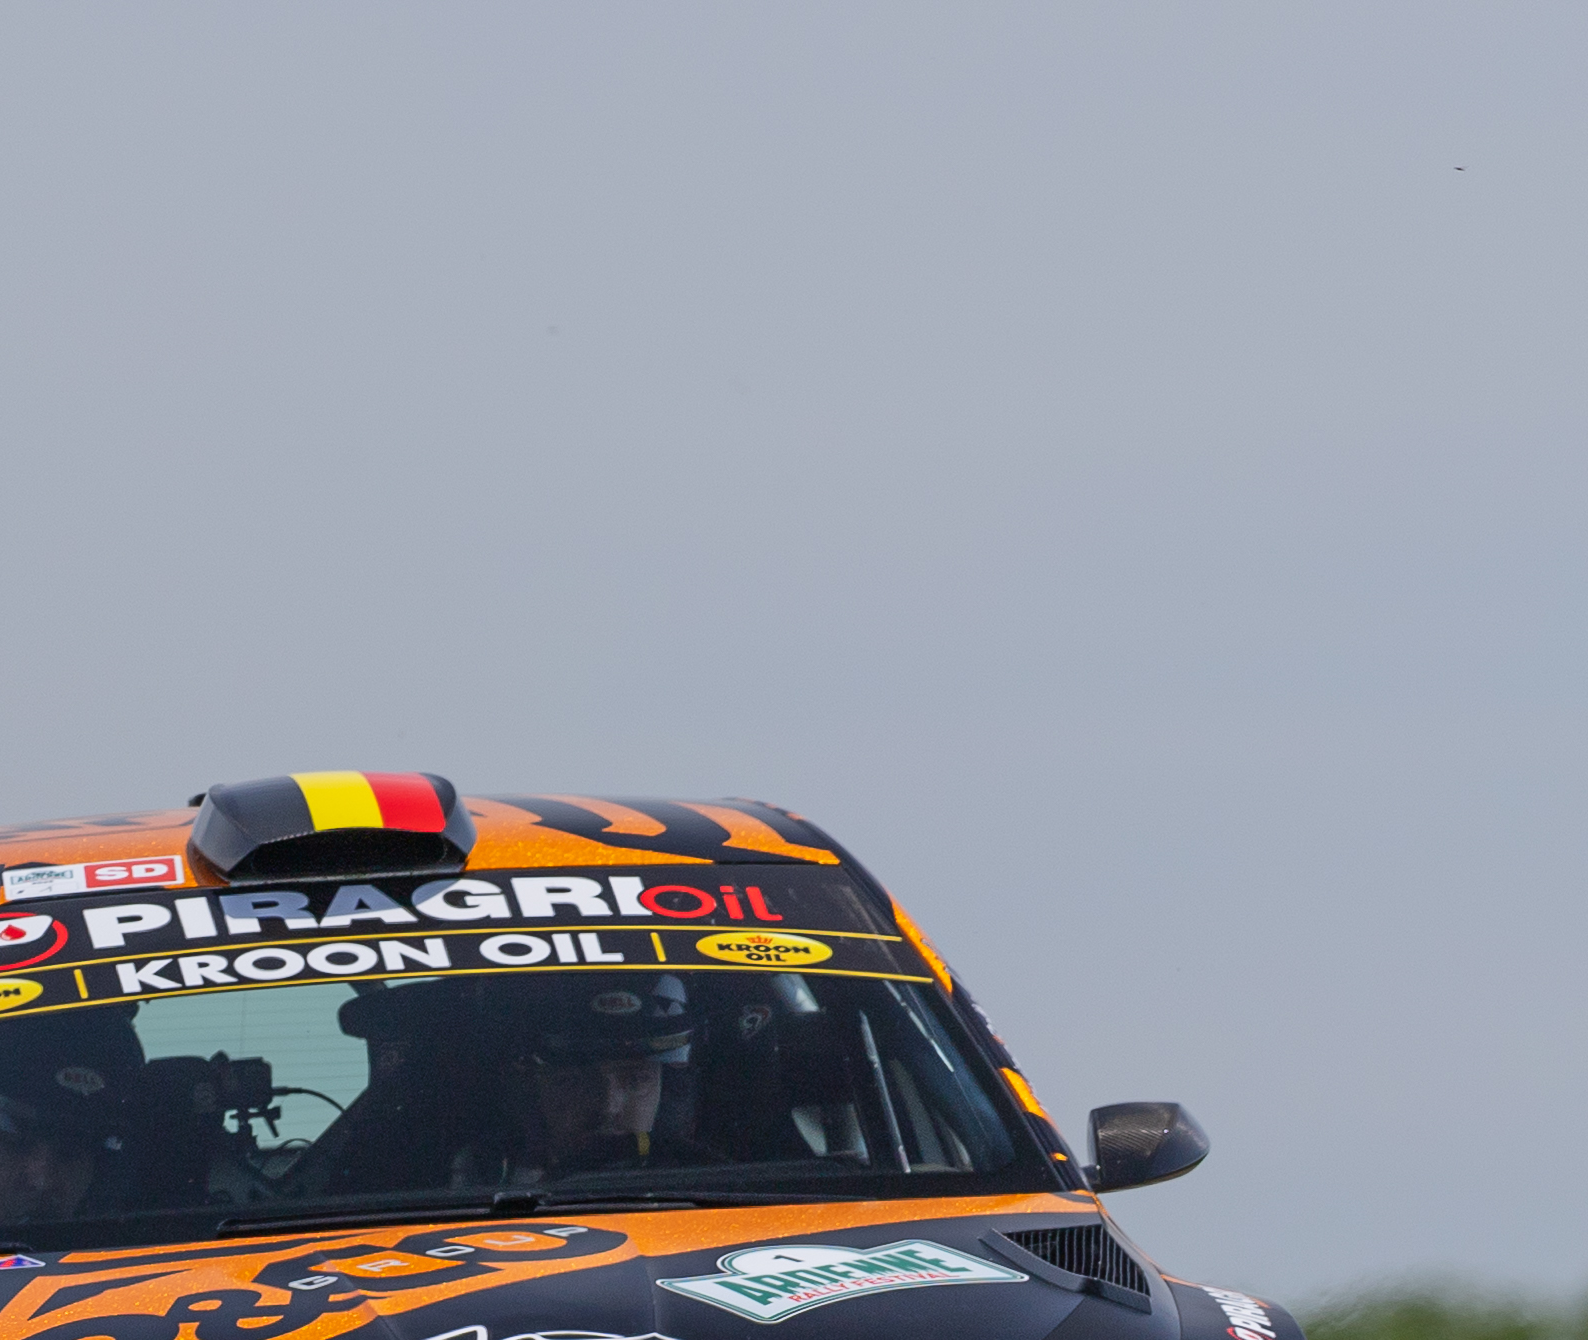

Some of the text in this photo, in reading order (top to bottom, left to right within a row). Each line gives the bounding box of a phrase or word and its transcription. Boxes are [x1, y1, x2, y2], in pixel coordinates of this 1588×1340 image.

[95, 863, 168, 881] SD
[716, 943, 811, 954] KROON
[746, 952, 787, 962] OIL
[116, 932, 625, 994] KROON OIL
[771, 1254, 803, 1264] 1
[715, 1249, 974, 1306] ARDENNE
[787, 1270, 960, 1304] RALLY FESTIVAL
